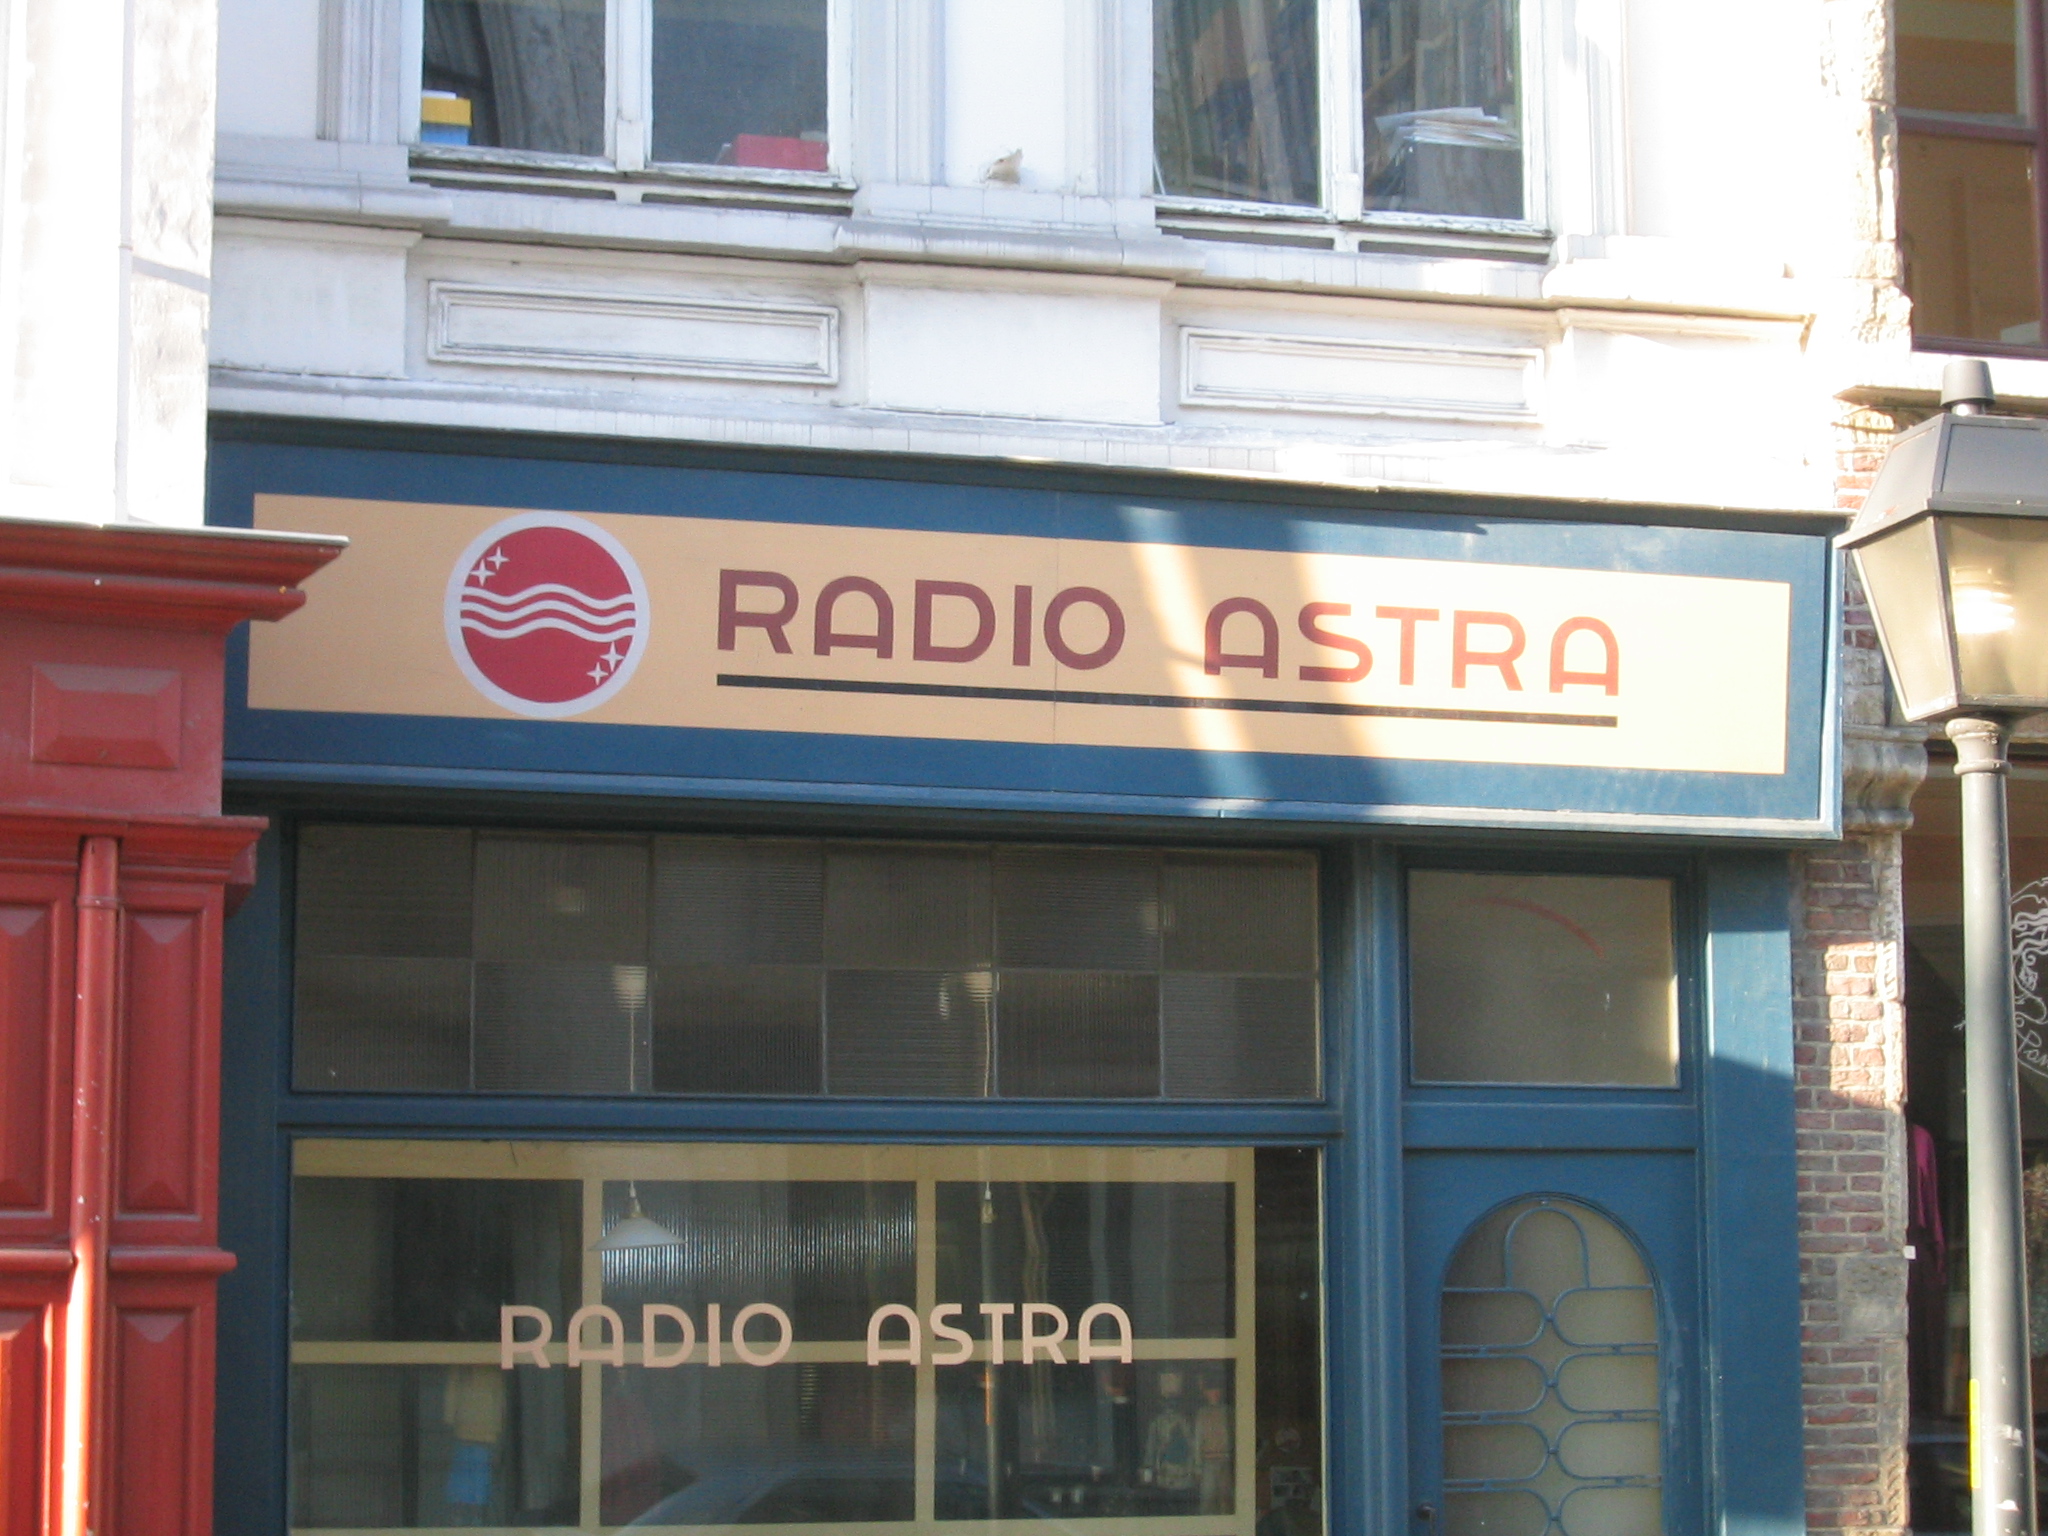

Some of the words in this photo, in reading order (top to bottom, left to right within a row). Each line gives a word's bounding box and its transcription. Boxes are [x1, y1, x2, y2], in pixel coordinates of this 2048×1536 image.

[717, 569, 1125, 670] RADIO
[1204, 596, 1619, 696] ASTRA
[500, 1303, 793, 1370] RADIO
[866, 1302, 1133, 1366] ASTRA
